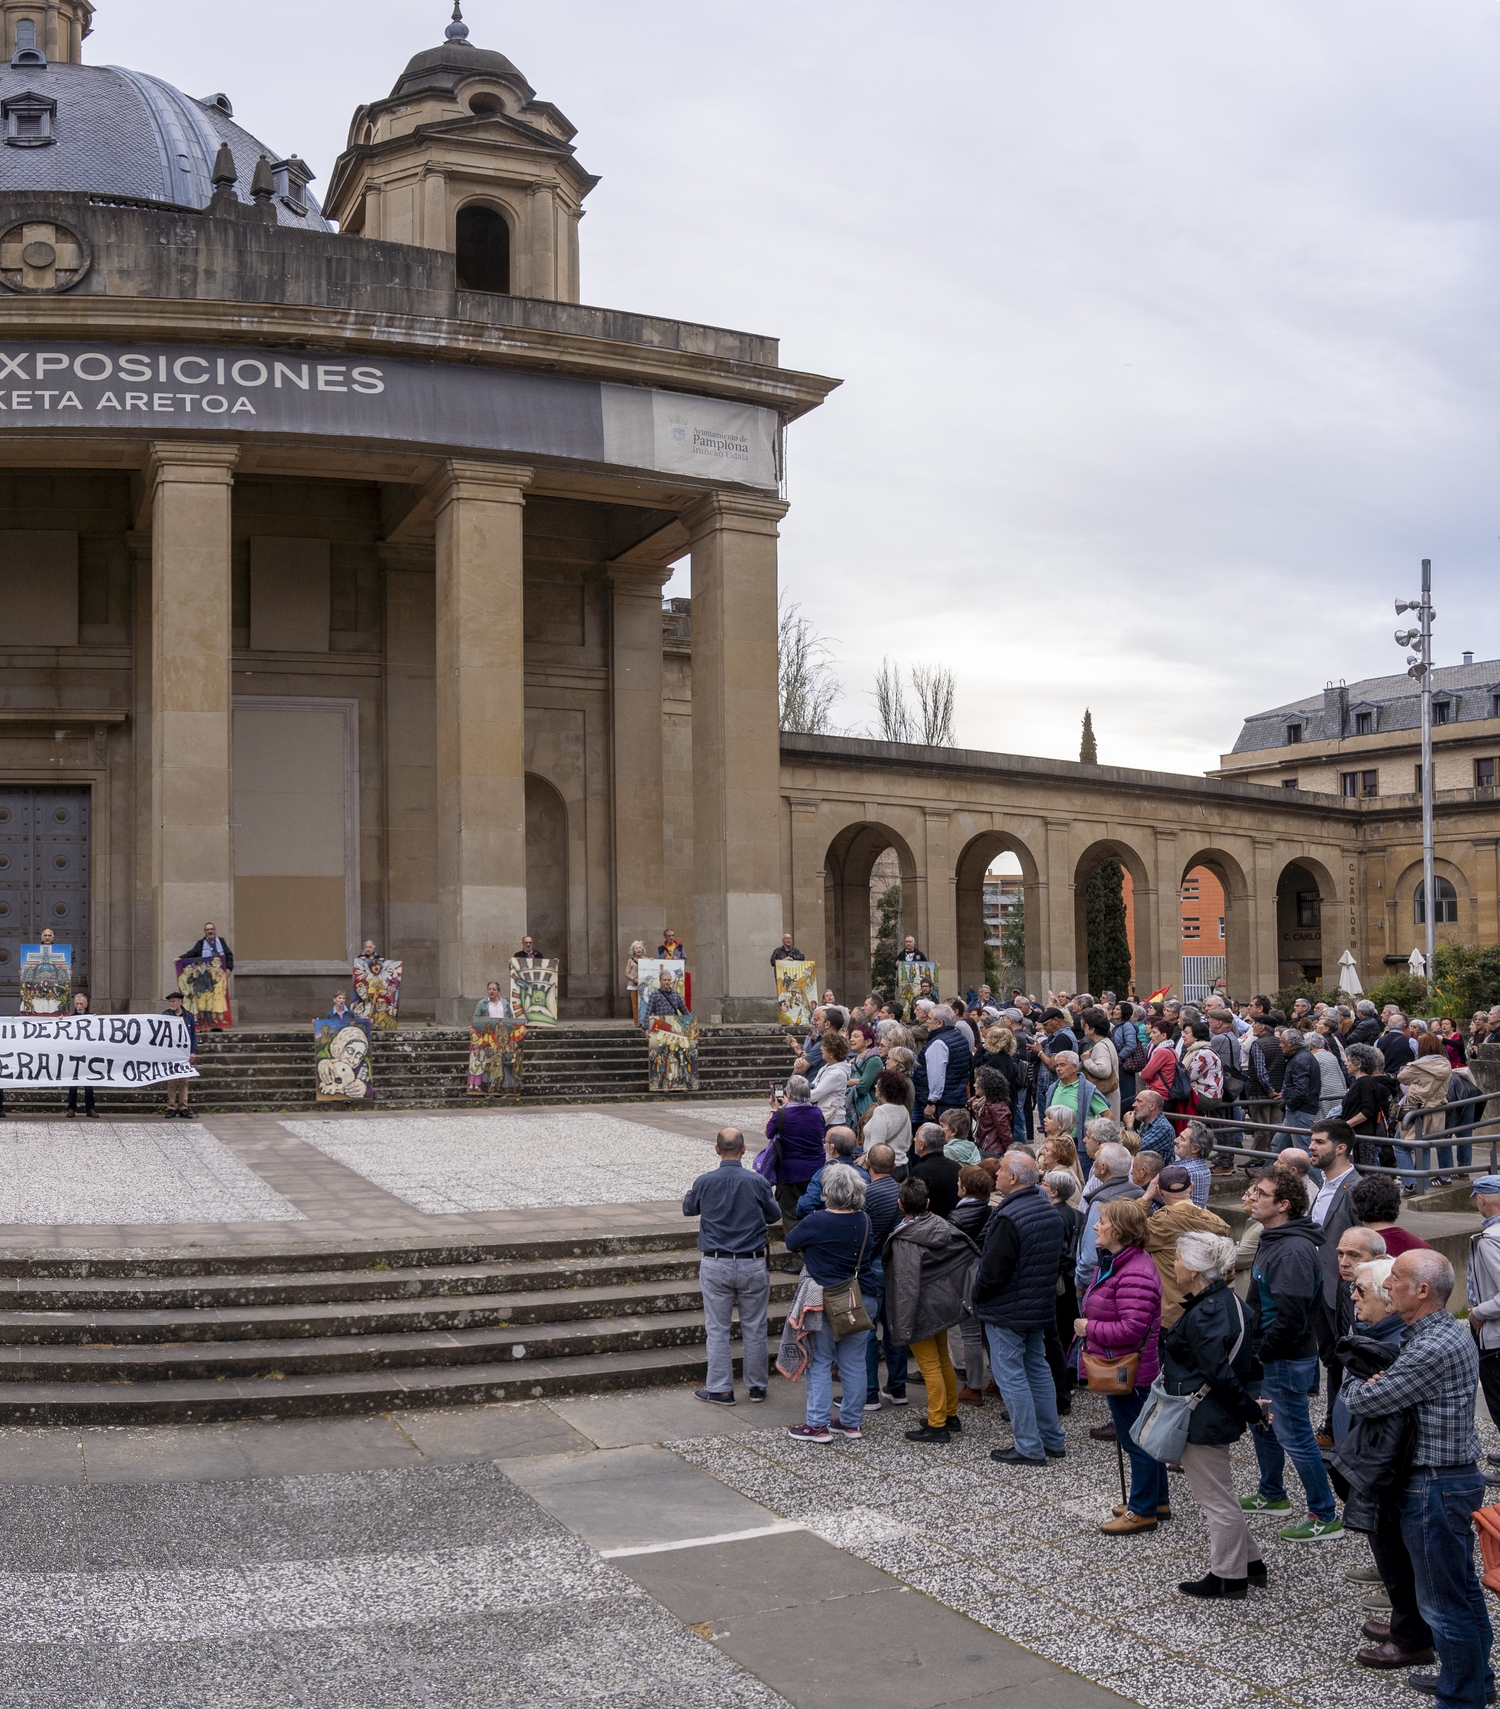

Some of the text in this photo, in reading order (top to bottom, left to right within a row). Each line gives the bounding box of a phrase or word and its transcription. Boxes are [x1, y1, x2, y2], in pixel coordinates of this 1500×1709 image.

[95, 390, 258, 415] ARETOA
[693, 427, 748, 443] Ayuntamiento de
[693, 434, 748, 453] Pamplona
[725, 451, 749, 461] Udala
[1349, 863, 1356, 872] C.
[1284, 932, 1321, 941] C. CARLO
